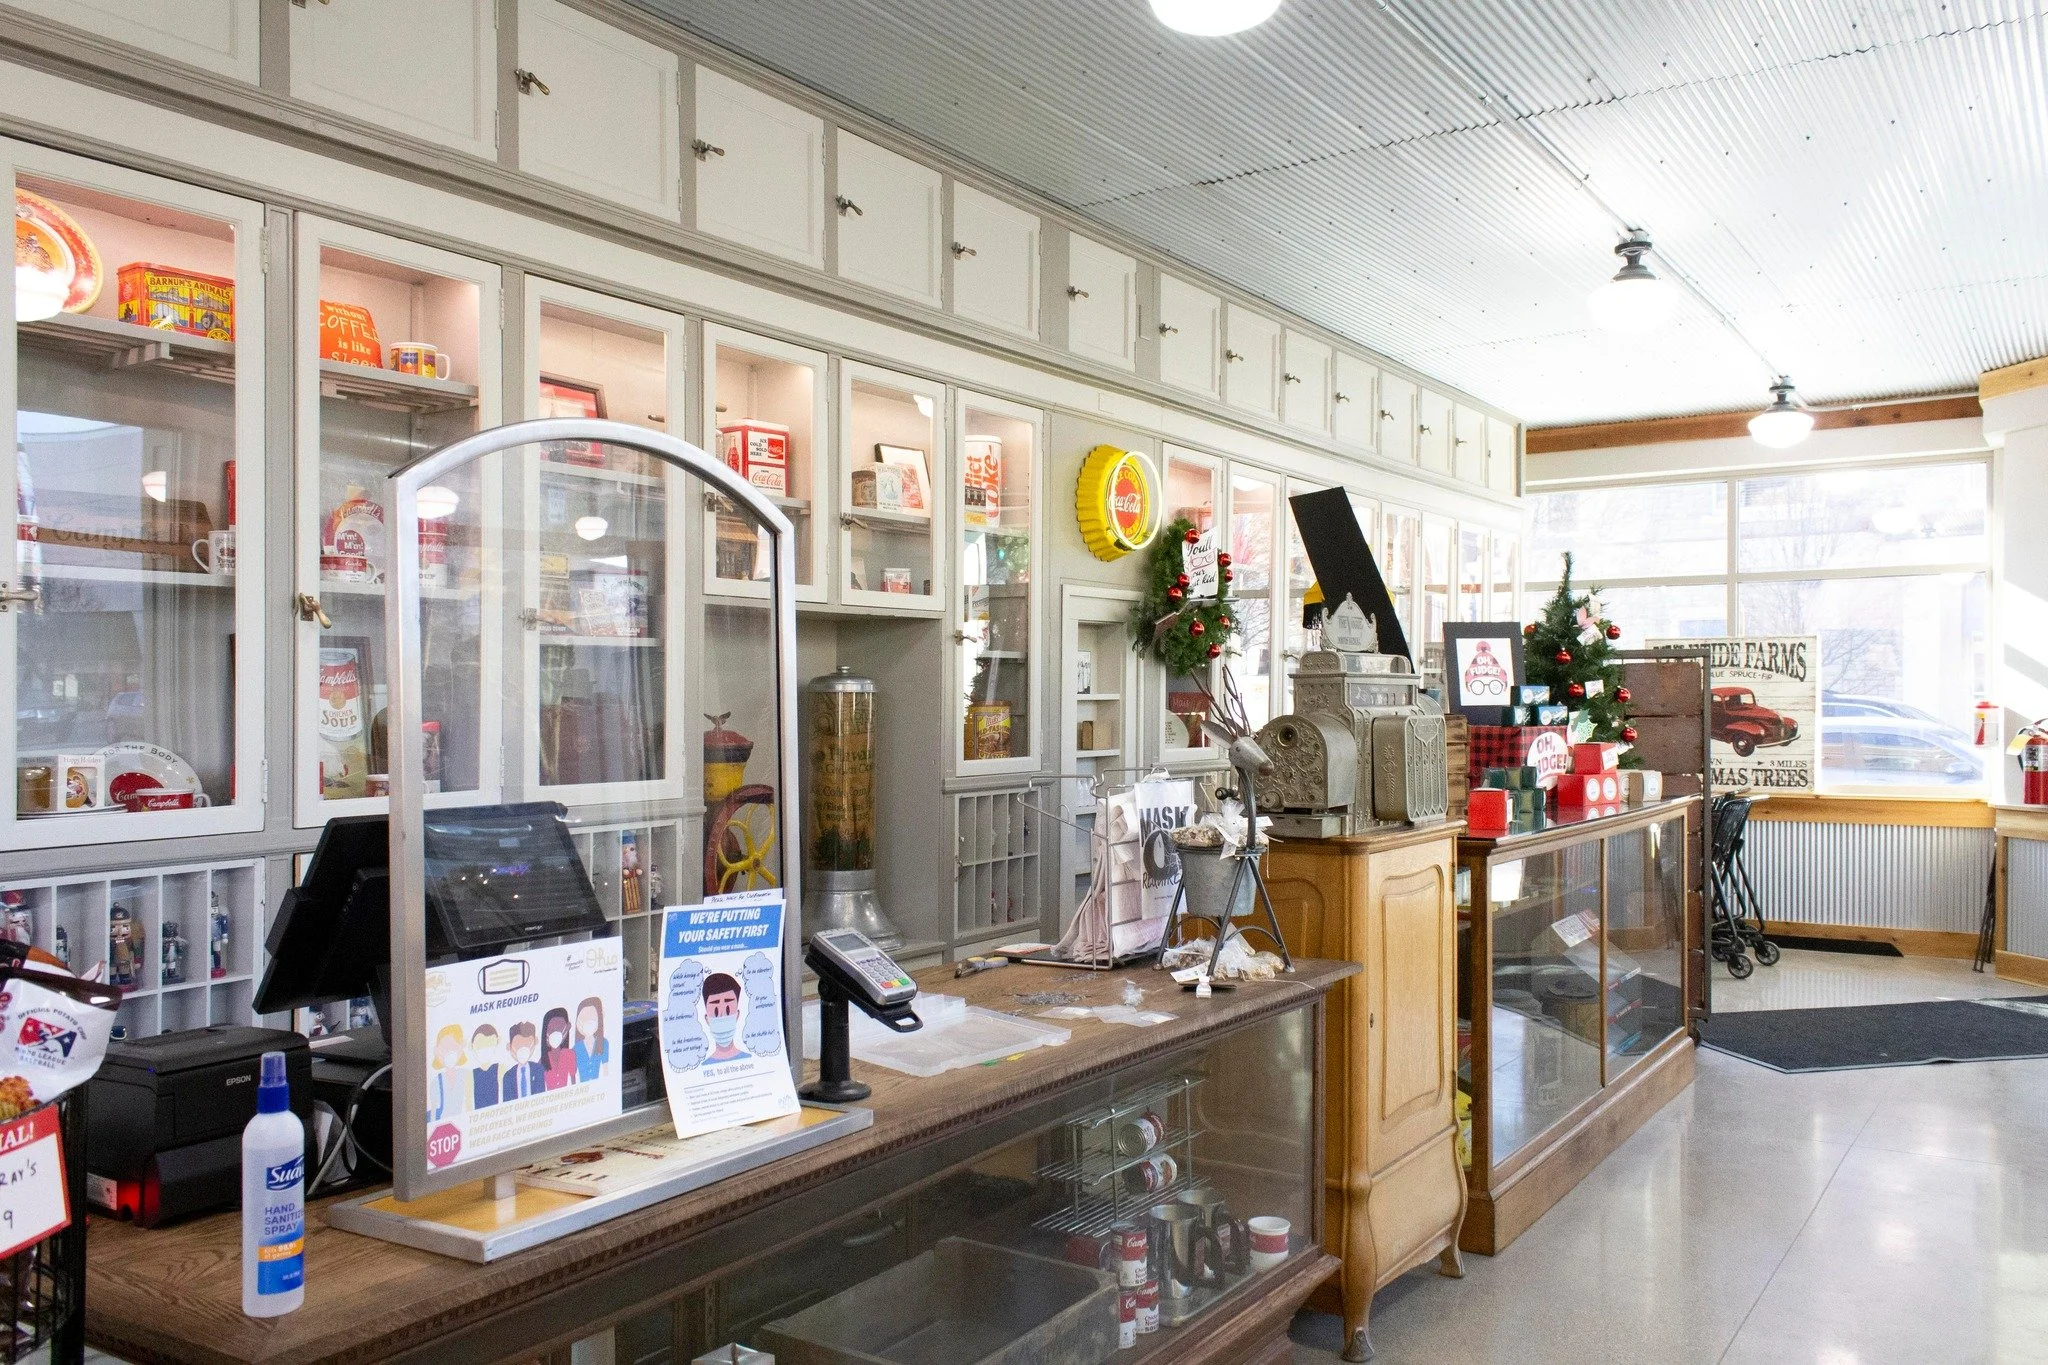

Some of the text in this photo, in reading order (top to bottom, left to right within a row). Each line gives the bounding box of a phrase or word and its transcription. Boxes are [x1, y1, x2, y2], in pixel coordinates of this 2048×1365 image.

[150, 277, 230, 299] BARNUM'S ANIMALS
[325, 304, 367, 321] without
[338, 338, 372, 355] is like
[752, 471, 784, 487] Coca-Cola
[1202, 573, 1215, 586] kid
[1471, 666, 1500, 675] FUDGE!
[1744, 642, 1806, 682] FARMS
[321, 710, 357, 728] SOUP
[1537, 736, 1555, 753] OH,
[63, 756, 80, 765] Happy
[103, 746, 120, 758] FOR
[150, 747, 179, 767] BODY.
[1538, 754, 1568, 774] DGE!
[1776, 760, 1808, 768] MILES
[1751, 768, 1809, 788] TREES
[115, 790, 139, 802] Cam
[1139, 806, 1190, 847] MASK
[690, 908, 761, 924] WE'RE PUTTING
[678, 924, 769, 943] YOUR SAFETY FIRST
[470, 993, 539, 1015] MASK REQUIRED
[18, 1007, 50, 1019] OFFICIAL
[53, 1009, 78, 1026] POTATO
[38, 1050, 67, 1065] LEAGUE
[740, 1063, 754, 1072] above
[226, 1075, 251, 1086] EPSON
[469, 1085, 590, 1123] TO PROTECT OUR CUSTOMERS AND
[469, 1092, 606, 1136] EMPLOYEES, WE REQUIRE EVERYONE TO
[469, 1135, 492, 1149] WEAR
[492, 1129, 512, 1142] FACE
[512, 1119, 553, 1137] COVERINGS
[430, 1134, 459, 1157] STOP
[265, 1203, 295, 1215] HAND
[4, 1210, 13, 1229] 9
[264, 1221, 298, 1236] SPRAY
